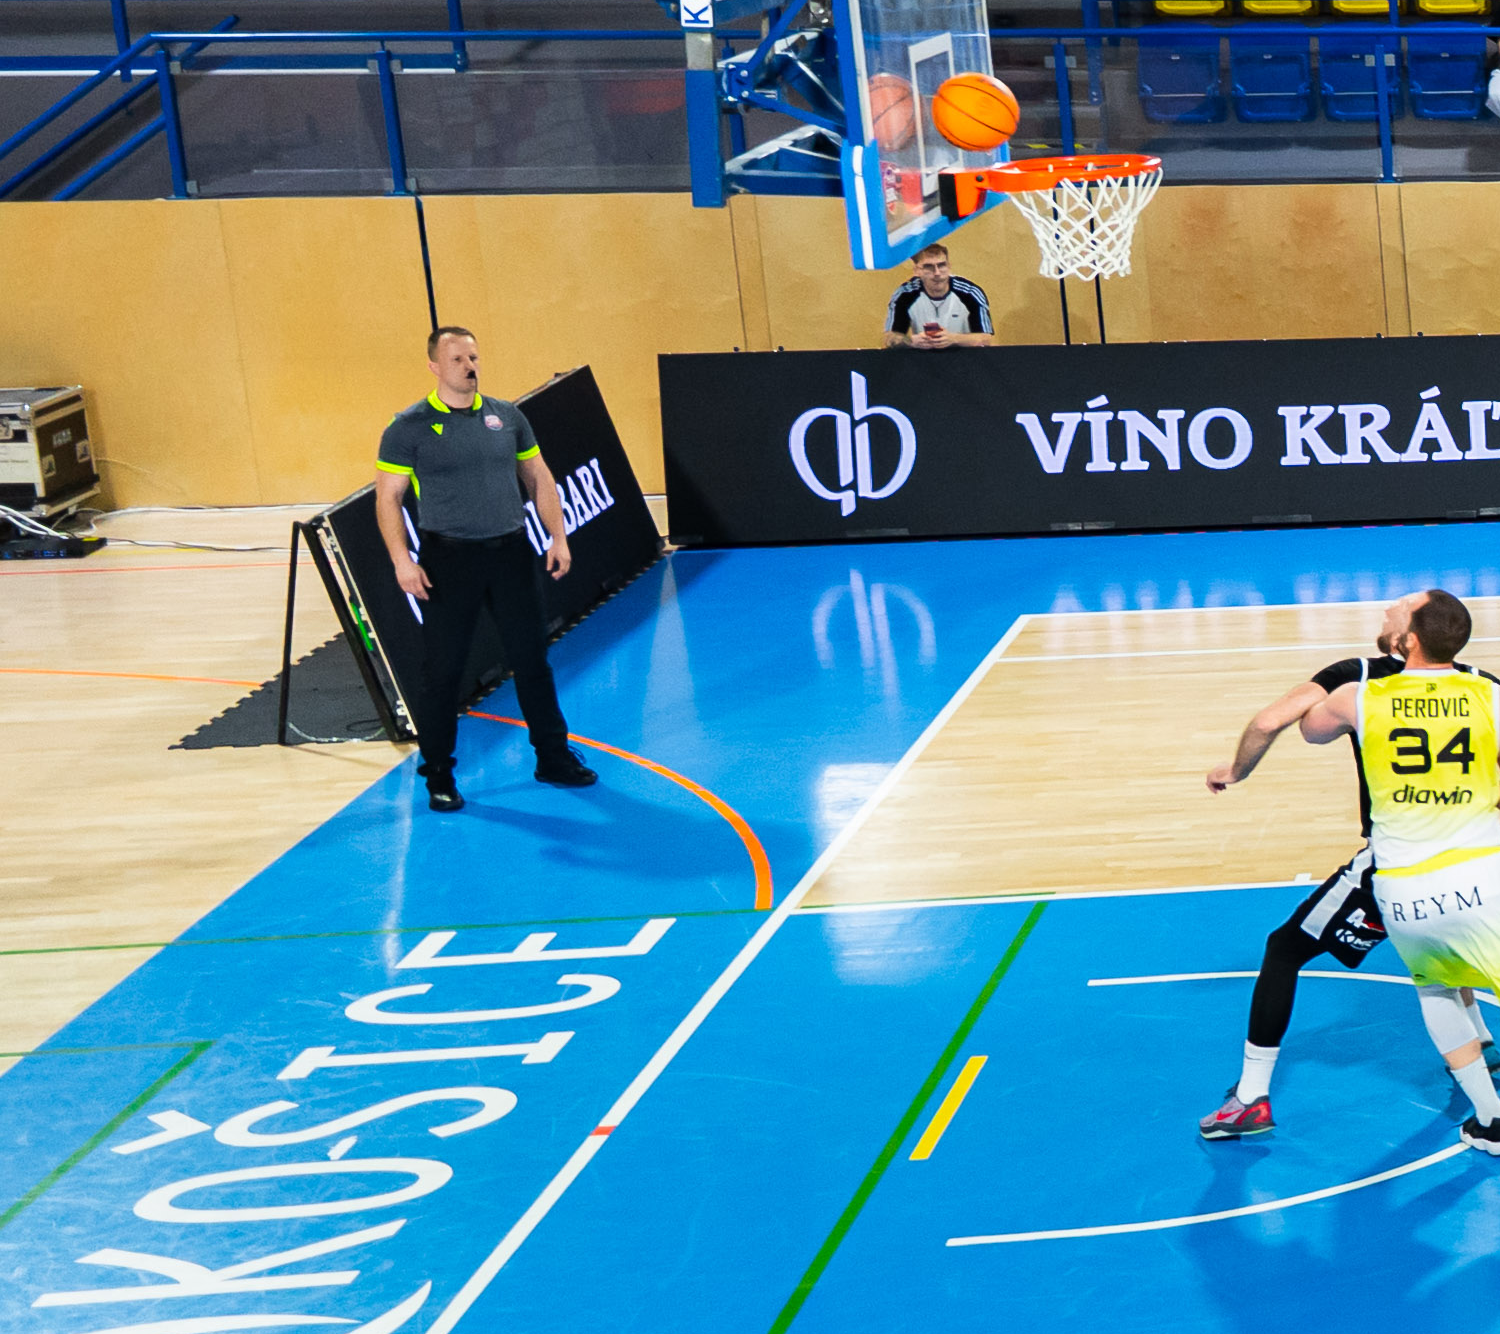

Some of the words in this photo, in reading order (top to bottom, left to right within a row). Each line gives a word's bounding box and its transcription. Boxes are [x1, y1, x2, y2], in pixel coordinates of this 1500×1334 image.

[1016, 394, 1253, 473] VÍNO
[1392, 695, 1470, 719] PEROVIĆ
[1388, 727, 1475, 775] 34
[1392, 784, 1472, 805] diawin
[32, 917, 676, 1308] KOŠICE
